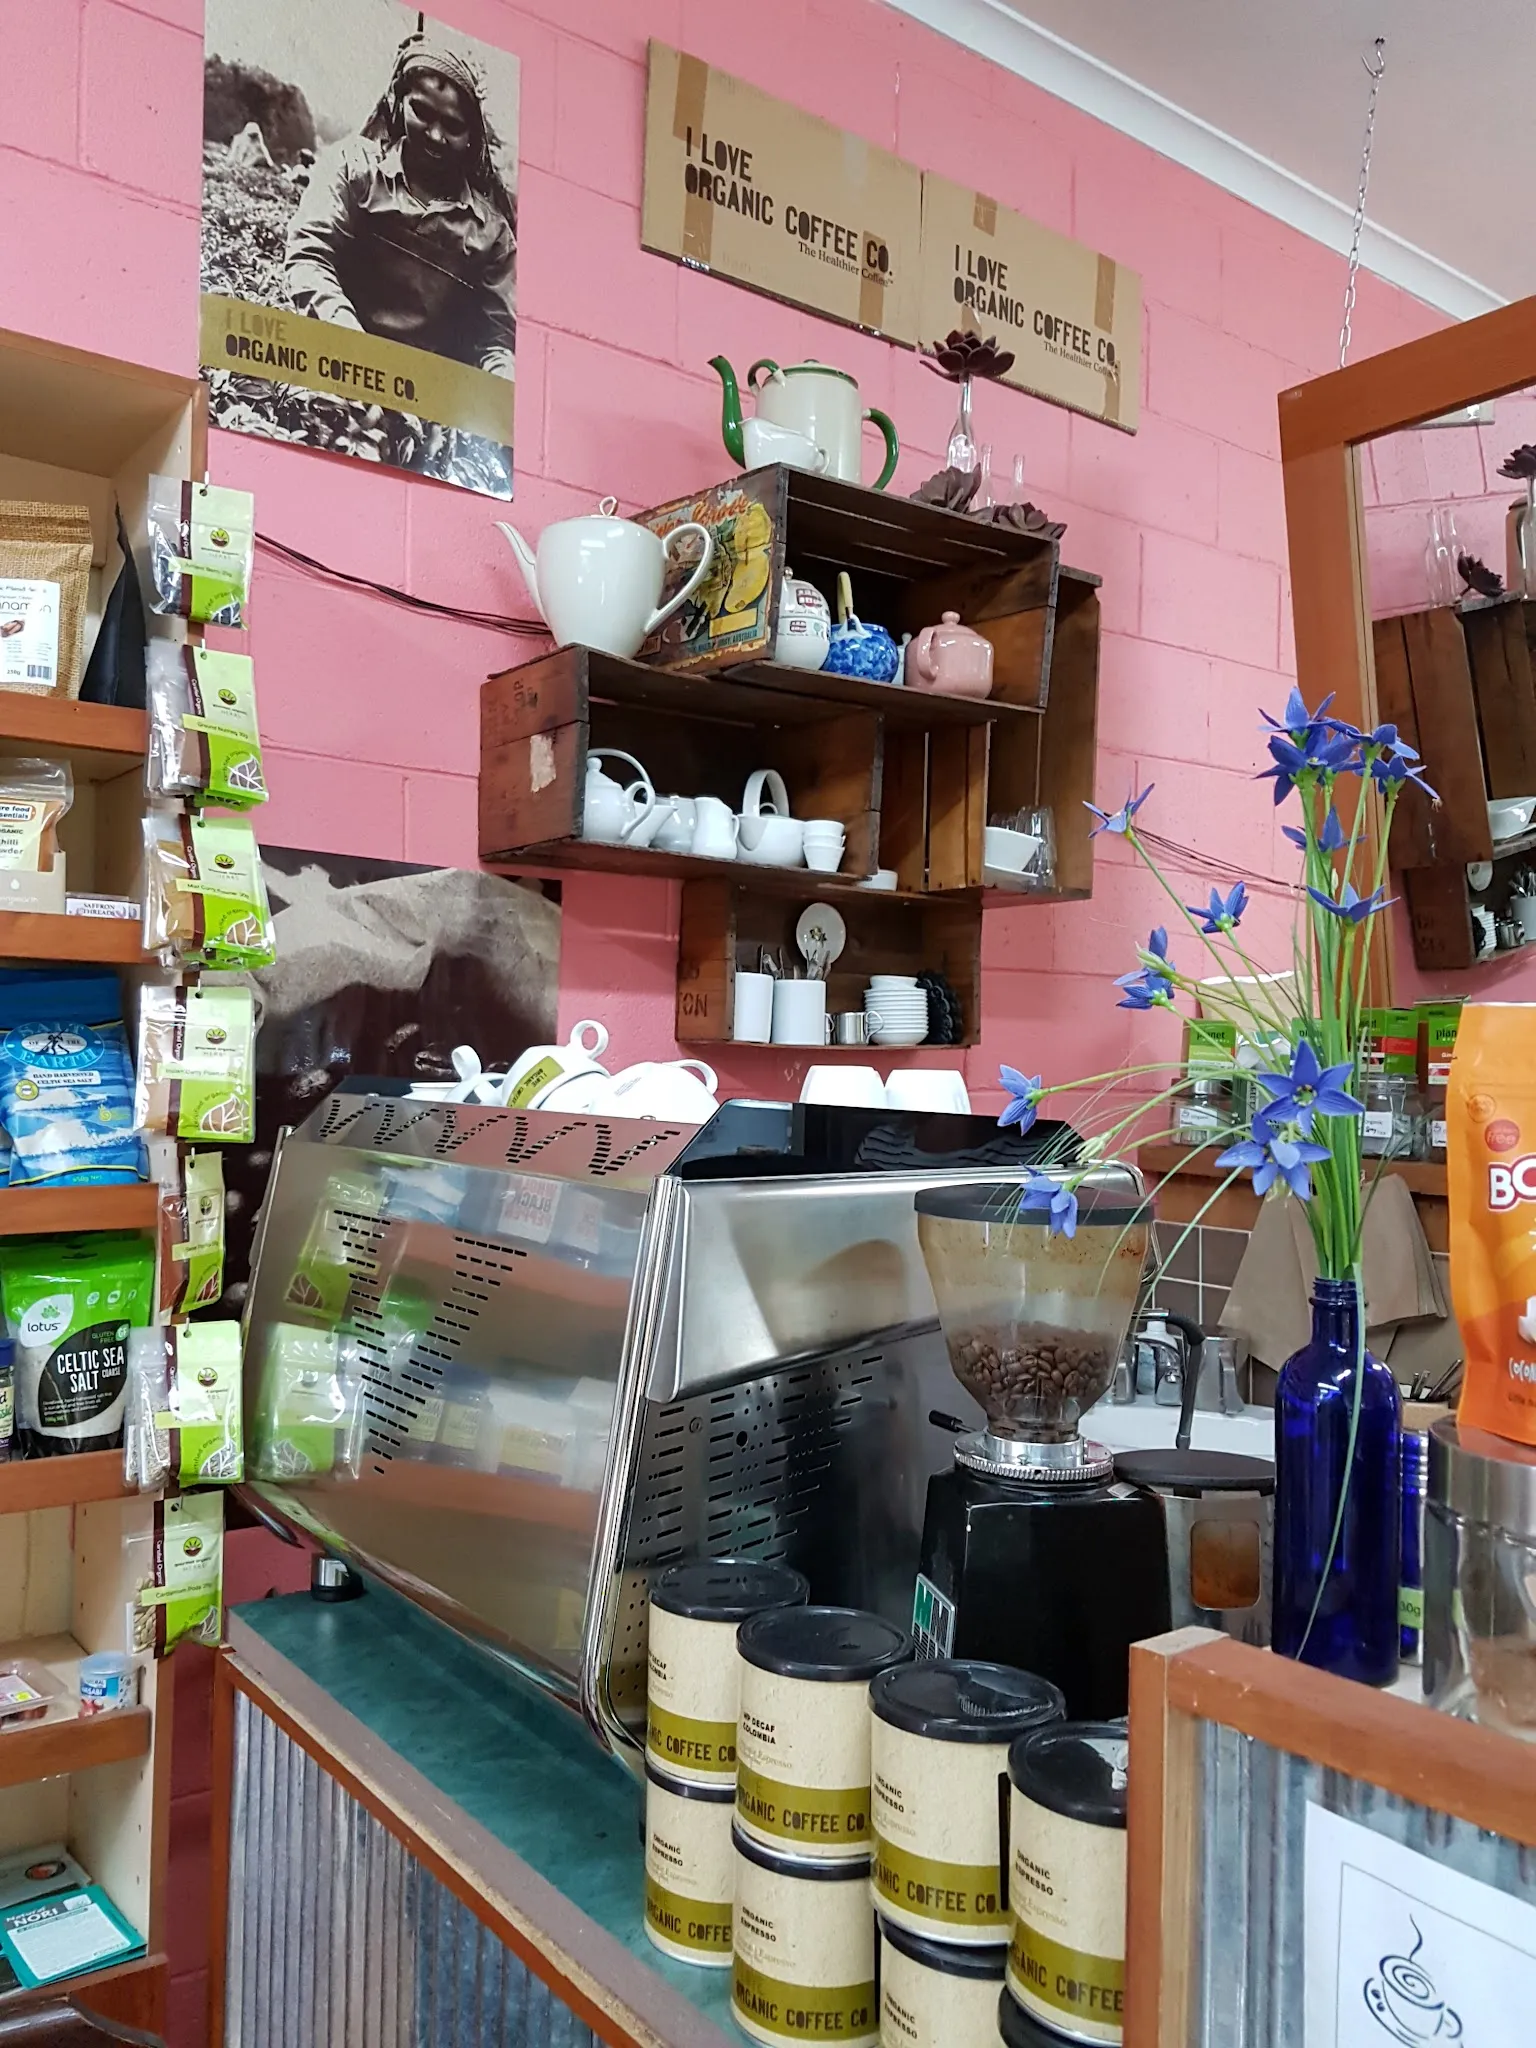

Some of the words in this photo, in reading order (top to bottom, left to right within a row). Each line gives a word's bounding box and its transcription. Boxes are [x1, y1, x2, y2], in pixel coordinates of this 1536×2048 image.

[686, 126, 693, 157] I
[701, 133, 753, 183] LOVE
[685, 163, 774, 226] ORGANIC
[785, 205, 858, 262] COFFEE
[866, 240, 893, 277] CO.
[798, 241, 816, 258] The
[818, 250, 859, 276] Healthier
[955, 244, 961, 272] I
[967, 249, 1008, 291] LOVE
[225, 309, 232, 330] I
[240, 312, 287, 342] LOVE
[953, 276, 1024, 328] ORGANIC
[1033, 309, 1091, 356] COFFEE
[1097, 337, 1119, 369] CO.
[225, 334, 307, 372] ORGANIC
[318, 356, 386, 393] COFFEE
[393, 376, 419, 403] CO.
[1043, 341, 1058, 354] The
[1059, 346, 1092, 370] Healthier
[82, 908, 116, 917] THREADS
[83, 902, 115, 911] SAFFRON
[20, 1047, 98, 1068] EARTH
[27, 1322, 61, 1333] lotus
[92, 1330, 115, 1340] GLUTEN
[117, 1327, 128, 1338] GF
[57, 1349, 100, 1374] CELTIC
[102, 1346, 125, 1368] SEA
[69, 1371, 100, 1393] SALT
[101, 1366, 121, 1378] COARSE
[743, 1721, 776, 1745] COLOMBIA
[752, 1716, 775, 1733] DECAF
[666, 1735, 712, 1761] COFFEE
[783, 1808, 840, 1833] COFFEE
[652, 1843, 683, 1867] ESPRESSO
[653, 1833, 681, 1855] ORGANIC
[1016, 1849, 1051, 1880] ORGANIC
[1015, 1862, 1054, 1896] ESPRESSO
[907, 1880, 967, 1913] COFFEE
[975, 1893, 1000, 1914] CO.
[6, 1905, 46, 1923] Natural
[13, 1907, 59, 1928] NORI
[742, 1906, 774, 1930] ORGANIC
[688, 1921, 733, 1943] COFFE
[741, 1917, 777, 1942] ESPRESSO
[736, 1979, 778, 2023] ORGANIC
[786, 2008, 844, 2031] COFFEE
[1056, 1974, 1125, 2013] COFFEE
